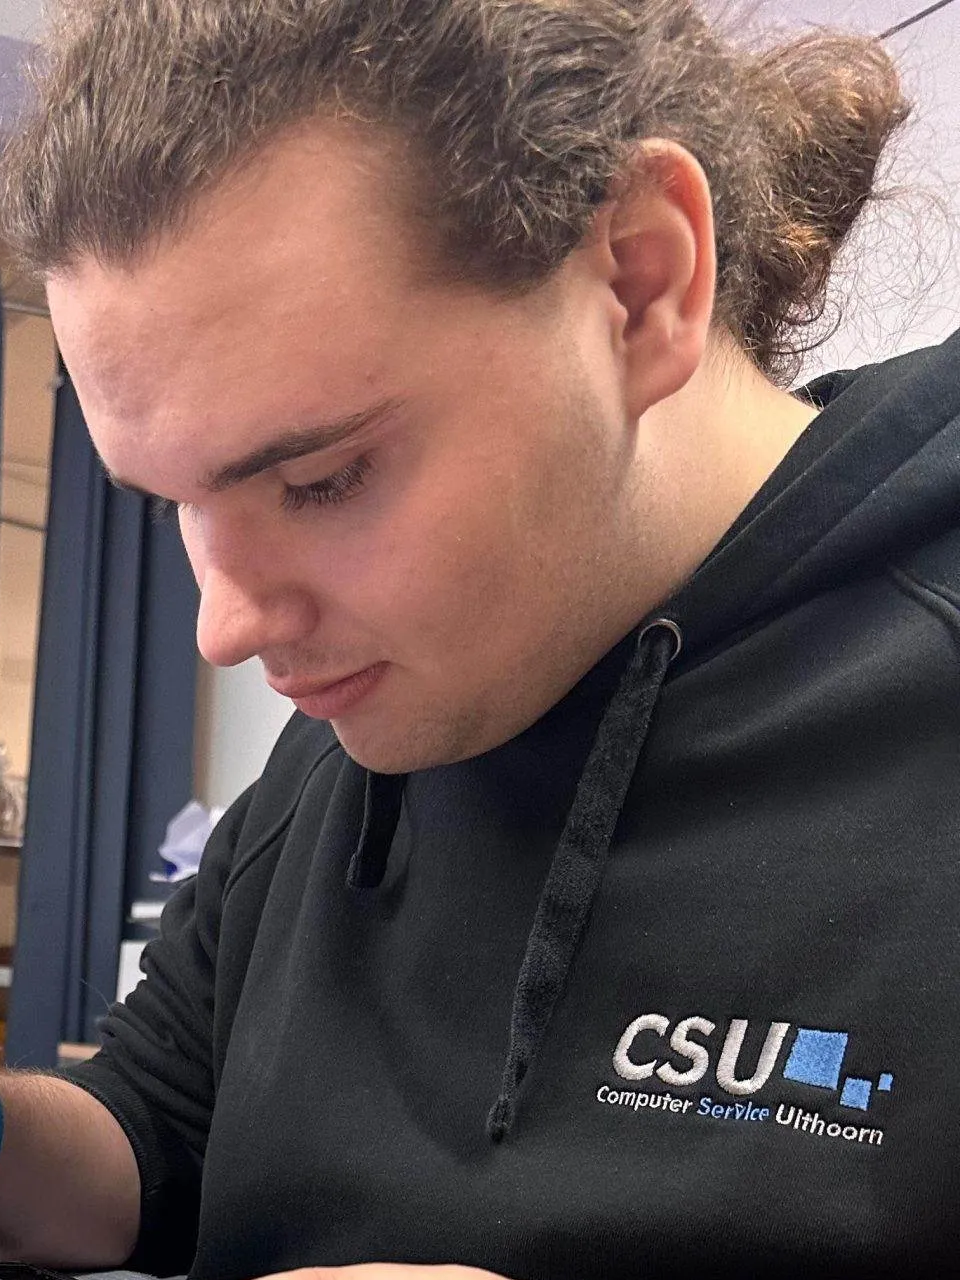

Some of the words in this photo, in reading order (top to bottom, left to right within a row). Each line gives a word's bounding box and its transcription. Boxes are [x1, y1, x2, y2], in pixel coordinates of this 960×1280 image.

[612, 1013, 791, 1095] CSU
[596, 1085, 694, 1114] Computer
[696, 1097, 770, 1121] Service
